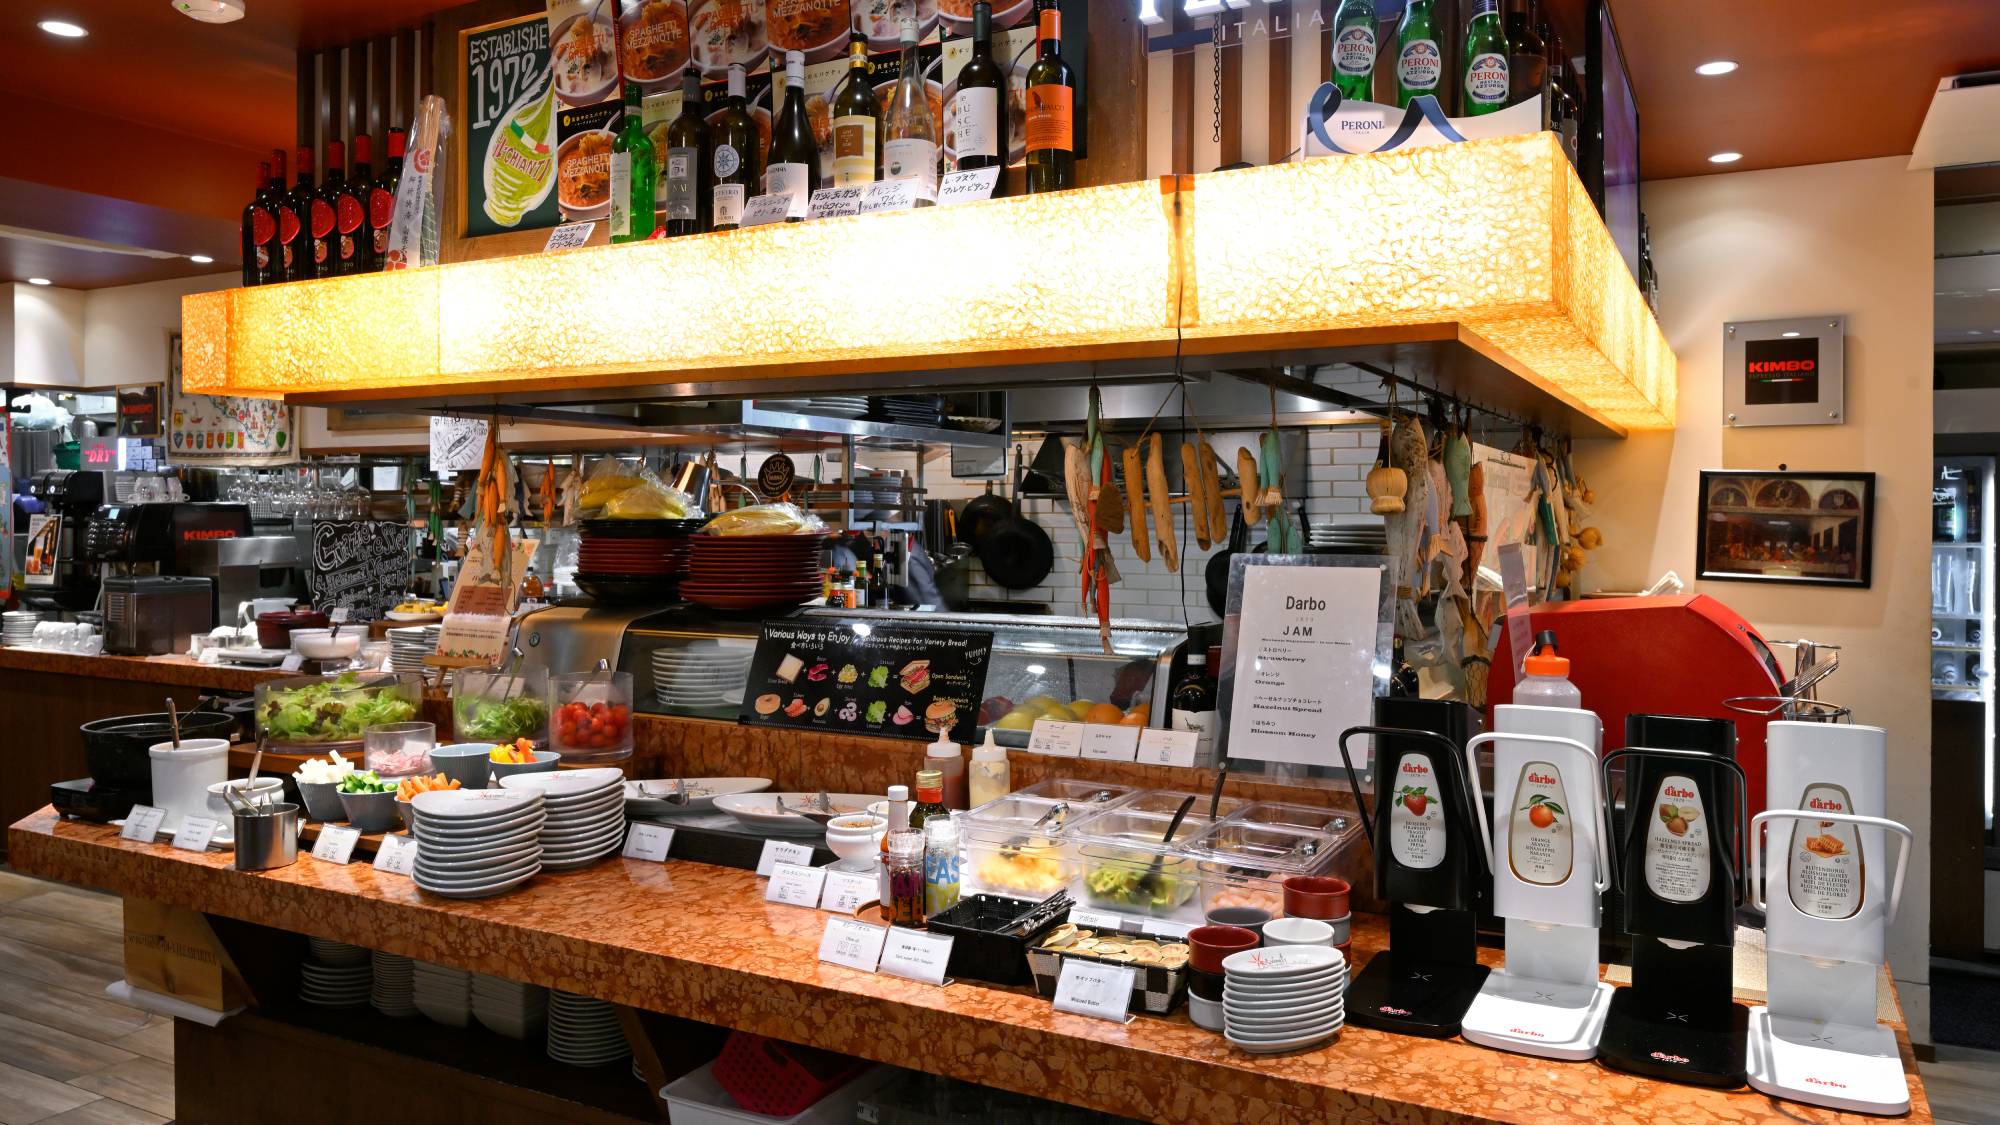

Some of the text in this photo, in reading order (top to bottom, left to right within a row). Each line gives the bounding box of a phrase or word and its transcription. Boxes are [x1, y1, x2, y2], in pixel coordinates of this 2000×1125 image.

[629, 20, 677, 40] SPAGHETTI
[1221, 10, 1324, 41] ITALIA
[469, 23, 550, 66] ESTABLISHE
[626, 29, 682, 50] MEZZANOTTE
[1338, 43, 1374, 55] PERONI
[1401, 57, 1439, 69] PERONI
[1470, 71, 1508, 83] PERONI
[472, 52, 539, 130] 1972
[1341, 120, 1382, 130] PERONI
[566, 163, 610, 178] MEZZANOTT
[1749, 359, 1815, 373] KIMBO
[1285, 596, 1326, 612] Darbo
[769, 628, 851, 645] Various Ways to Enjoy
[1257, 655, 1306, 663] Strawberry
[1254, 679, 1285, 687] Orange
[1253, 703, 1322, 714] Hazelnut Spread
